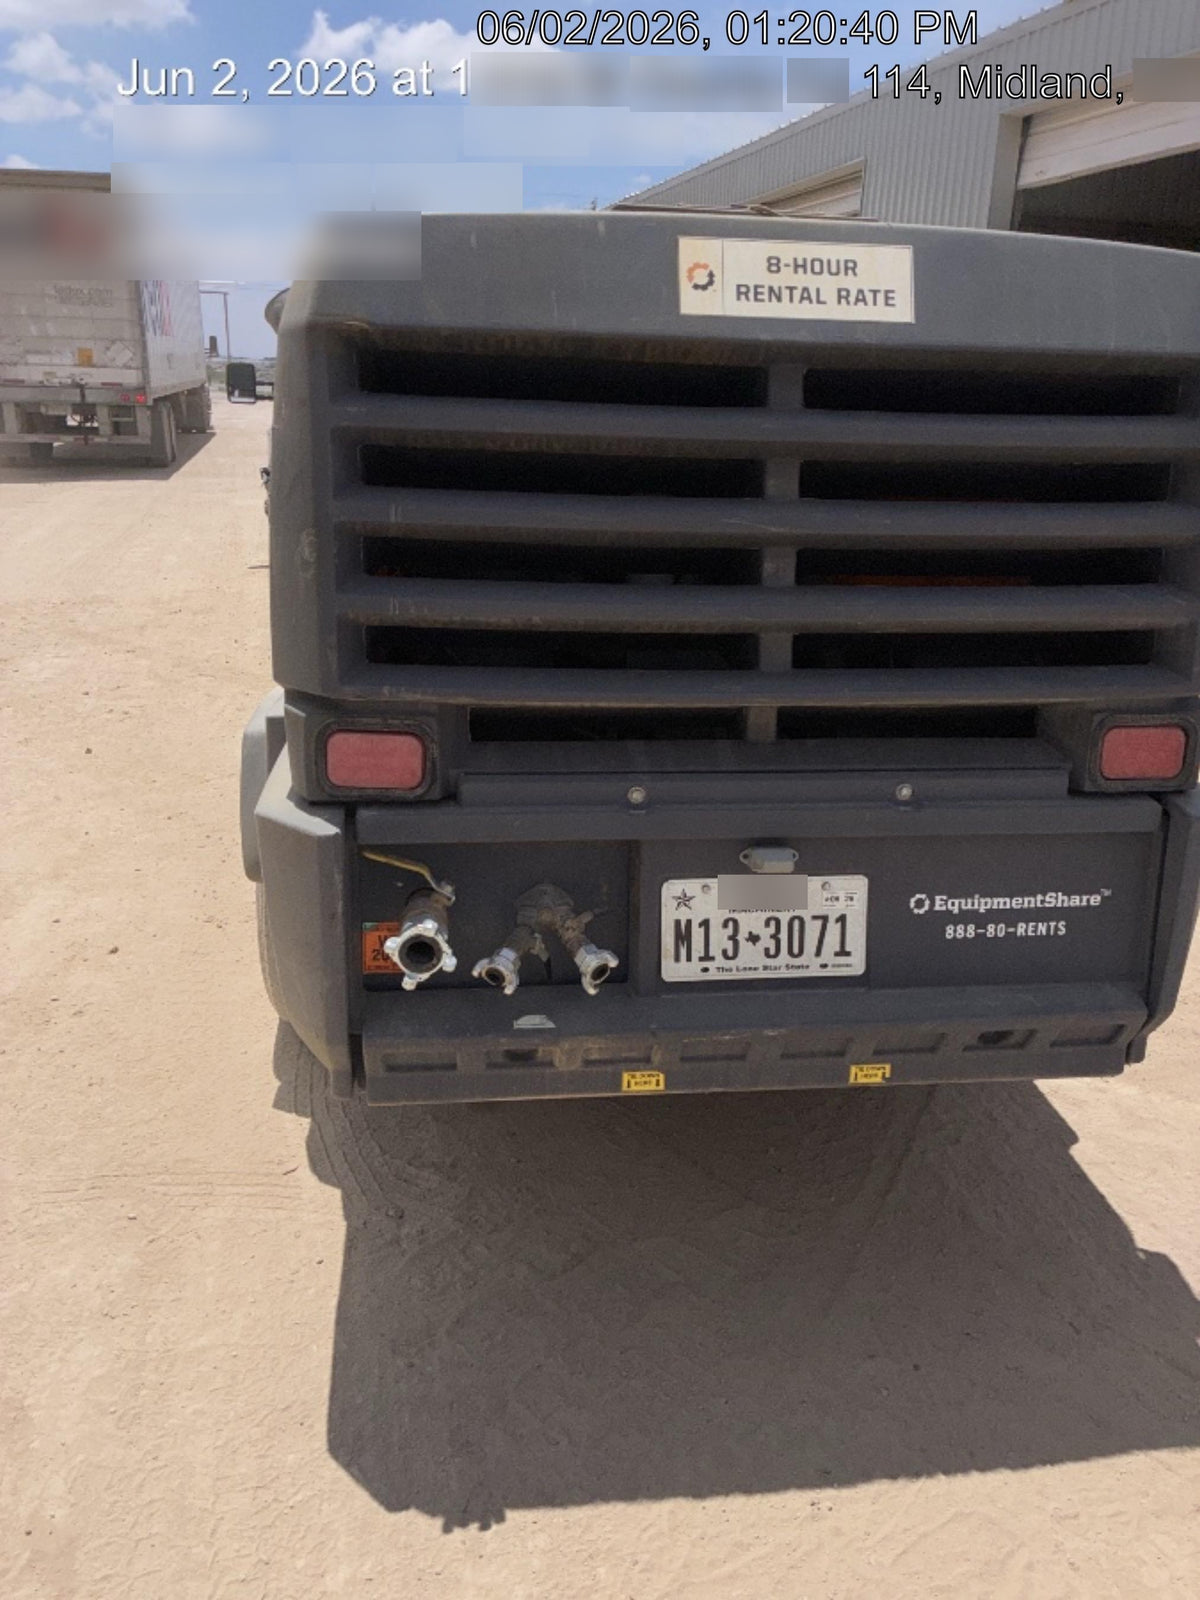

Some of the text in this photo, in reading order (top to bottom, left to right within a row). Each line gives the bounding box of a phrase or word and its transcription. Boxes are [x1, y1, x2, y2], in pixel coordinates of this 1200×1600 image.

[766, 256, 858, 277] 8-HOUR
[735, 284, 897, 307] RENTAL RATE
[933, 892, 1101, 914] EquipmentShare
[945, 921, 1067, 939] 888-80-RENTS
